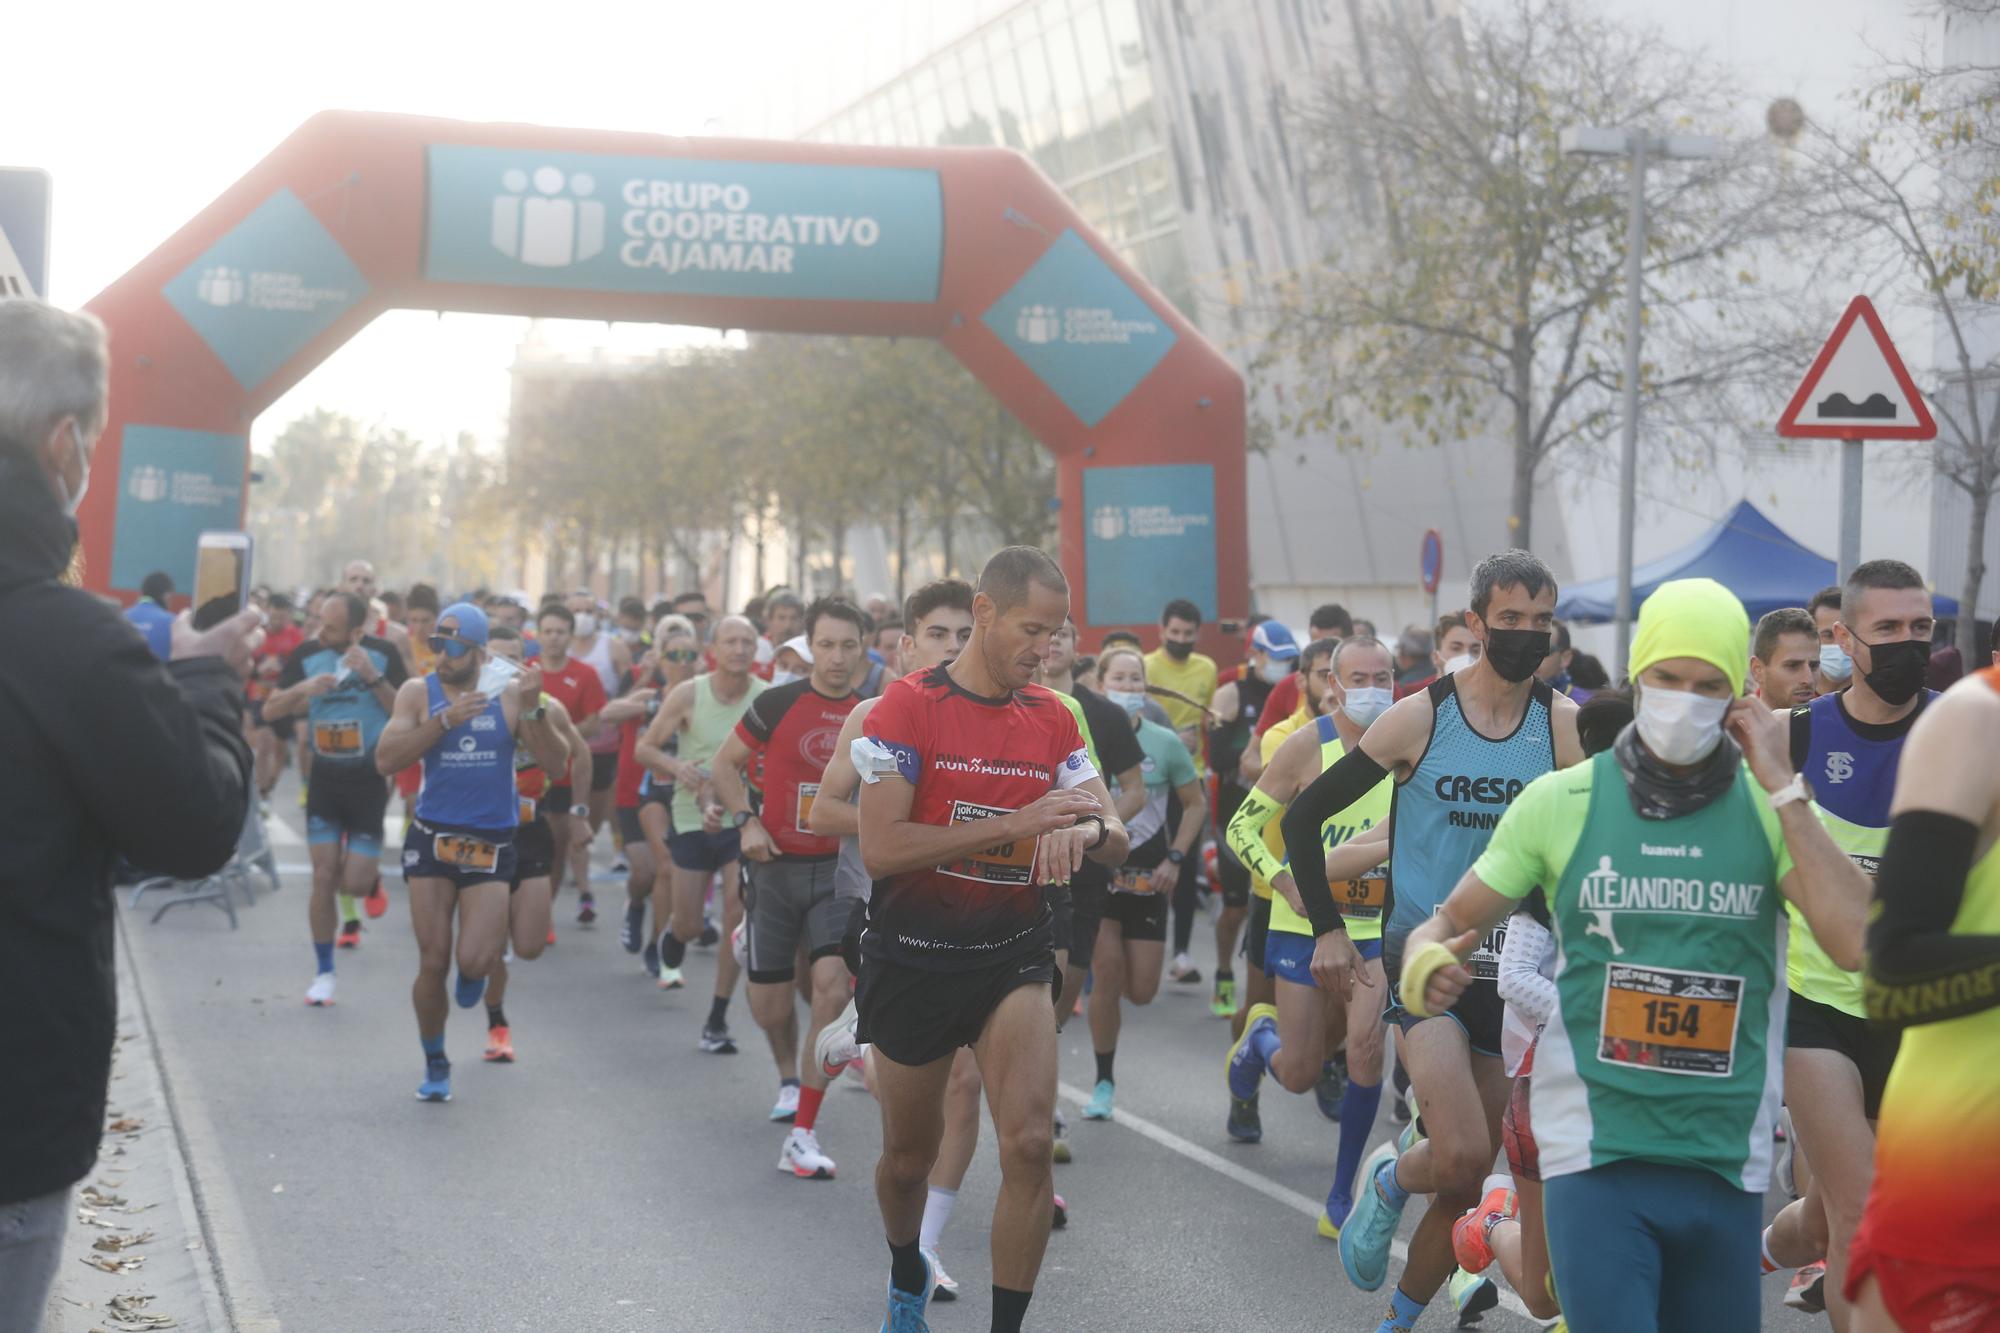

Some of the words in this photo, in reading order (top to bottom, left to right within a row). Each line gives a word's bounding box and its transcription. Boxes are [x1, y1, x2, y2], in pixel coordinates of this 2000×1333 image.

[622, 179, 750, 212] GRUPO
[622, 209, 881, 247] COOPERATIVO
[620, 240, 796, 275] CAJAMAR
[936, 753, 968, 772] RUN
[1435, 775, 1531, 805] CRESP
[1450, 811, 1503, 831] RUNN
[1347, 880, 1369, 899] 35
[1578, 877, 1704, 911] ALEJANDRO
[1709, 881, 1764, 916] SANZ
[1643, 1000, 1700, 1038] 154
